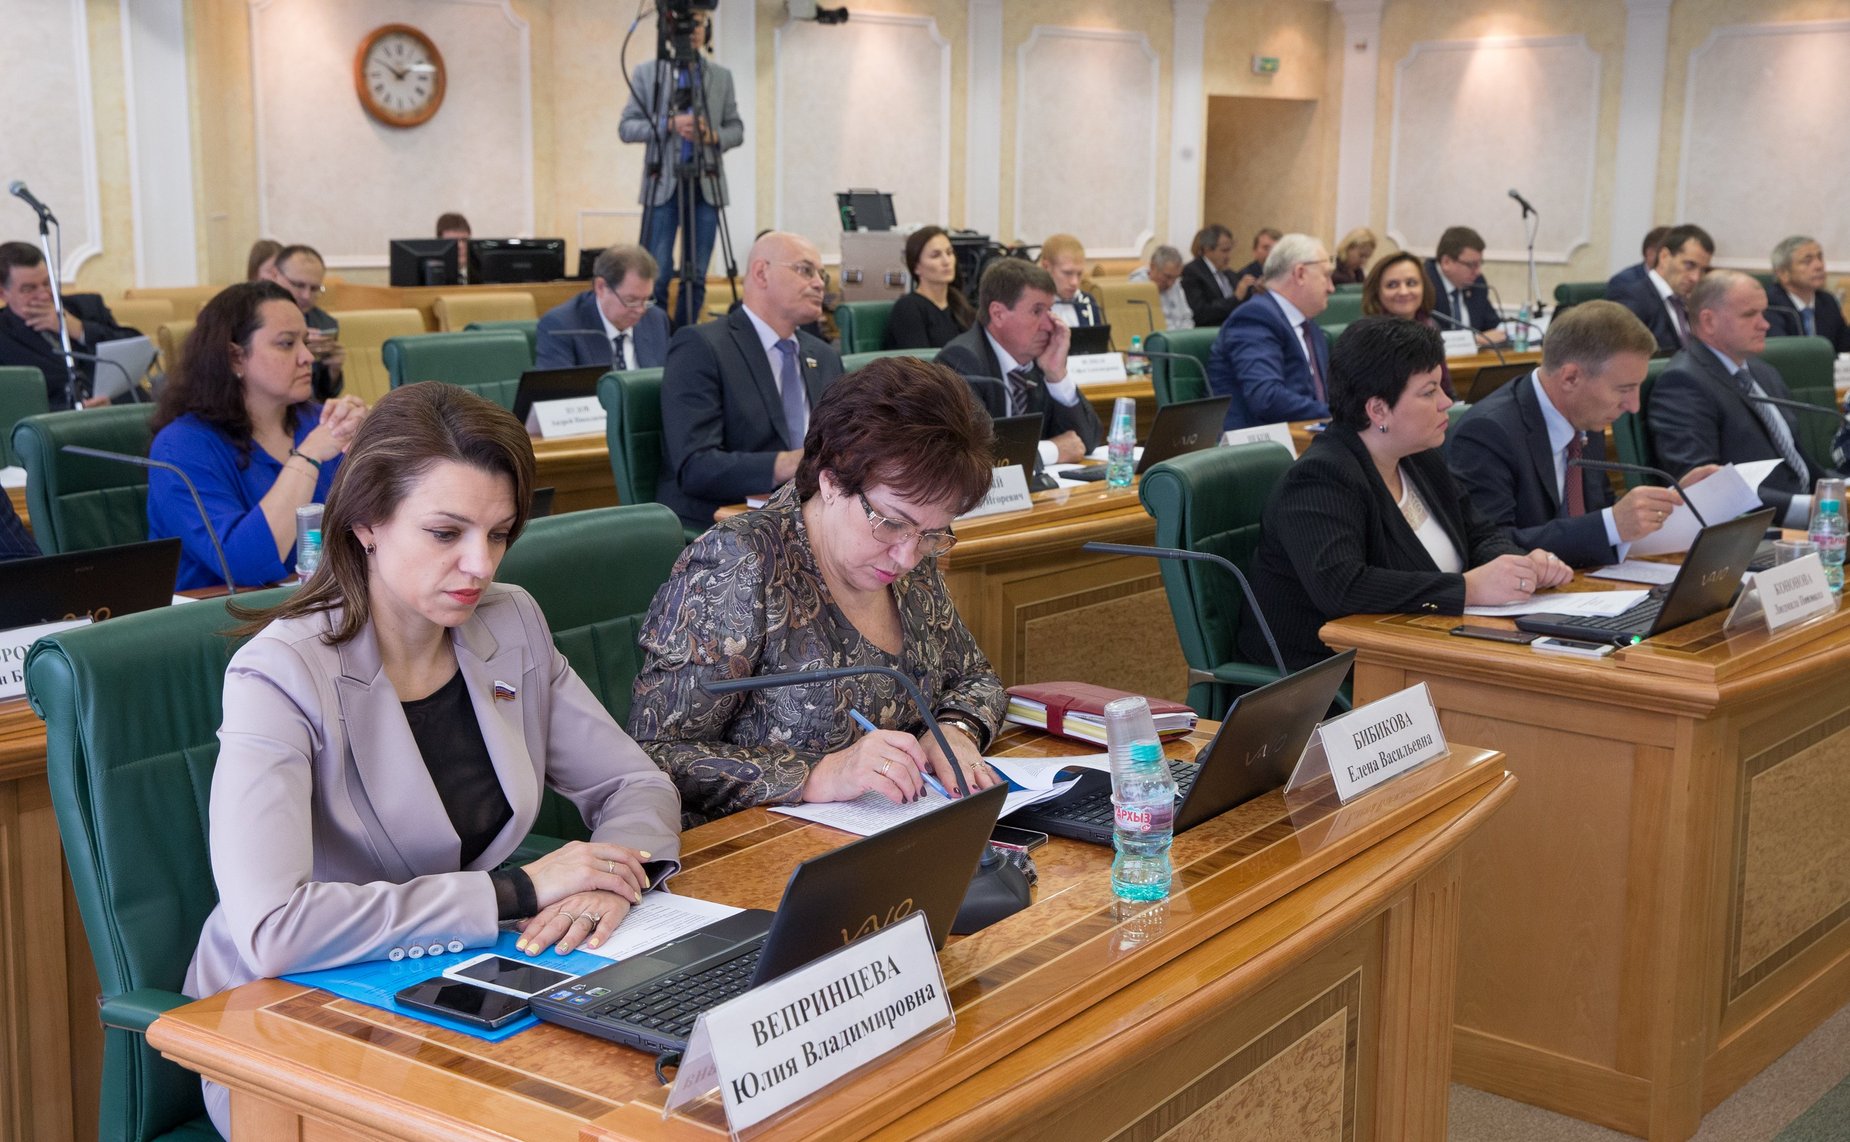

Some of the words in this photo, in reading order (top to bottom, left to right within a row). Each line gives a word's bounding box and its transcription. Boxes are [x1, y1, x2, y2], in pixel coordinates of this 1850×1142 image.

[1347, 759, 1380, 783] Елена
[1378, 733, 1433, 768] Васильевна
[1352, 711, 1413, 750] БИБИКОВА
[750, 955, 902, 1048] ВЕПРИНЦЕВА
[731, 1057, 799, 1105] Юлия
[801, 983, 936, 1068] Владимировна
